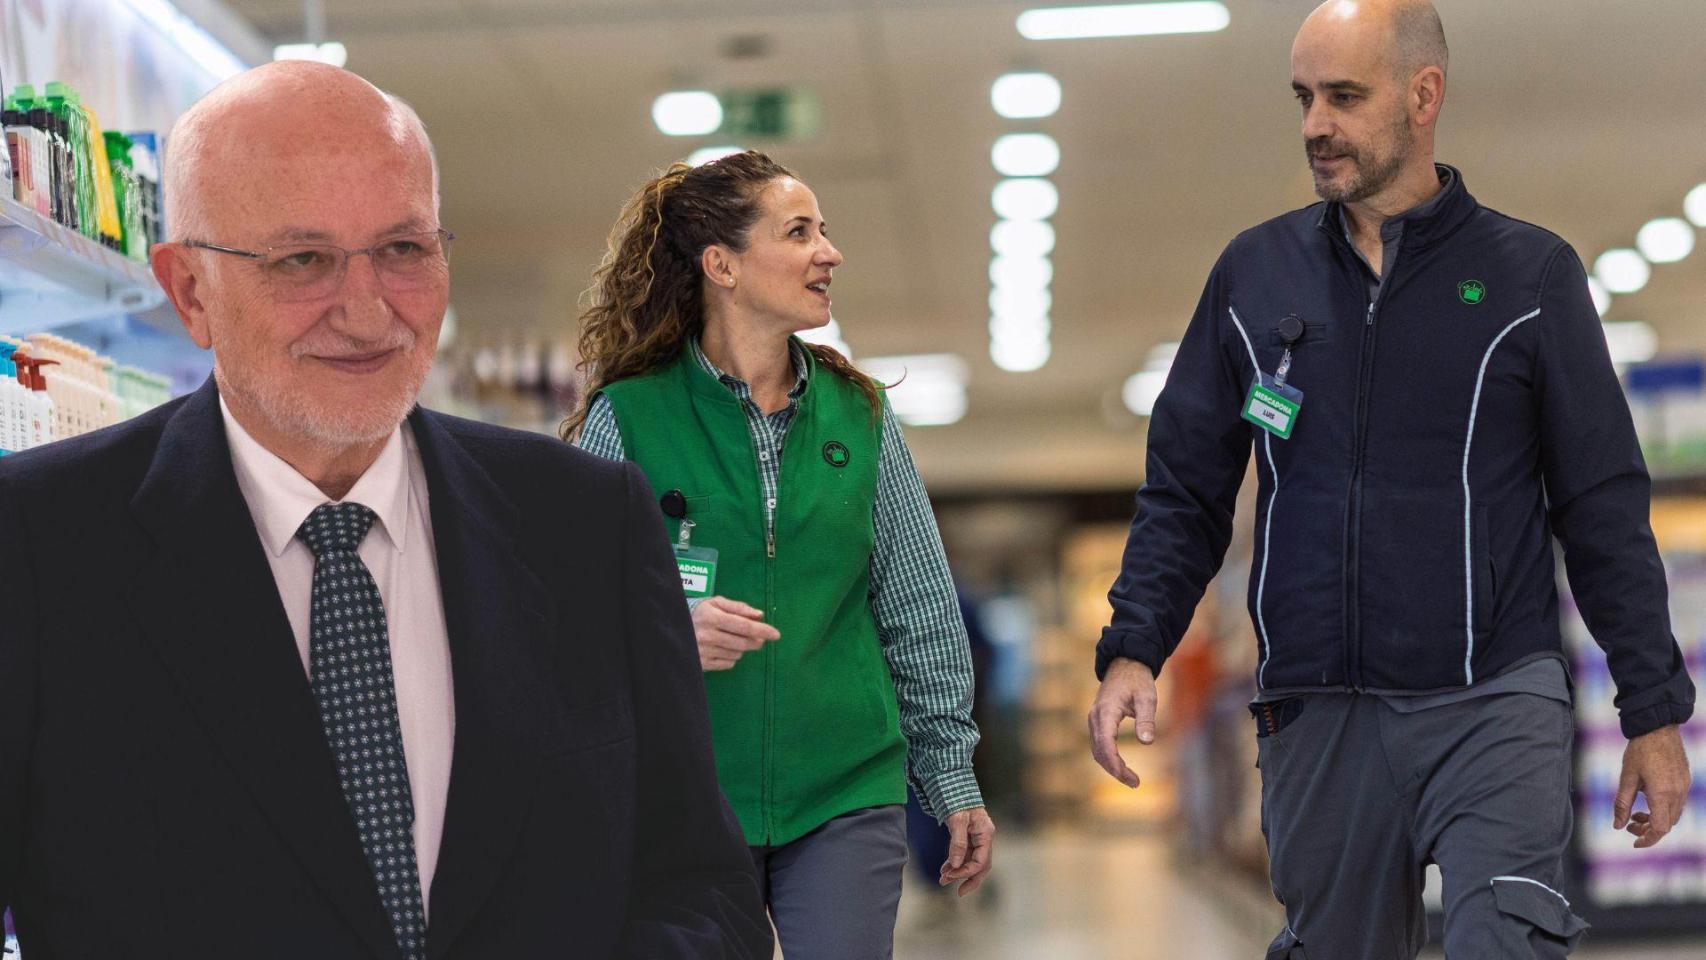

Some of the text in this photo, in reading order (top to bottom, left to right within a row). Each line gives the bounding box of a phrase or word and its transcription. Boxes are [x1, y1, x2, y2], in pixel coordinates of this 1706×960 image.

[1254, 390, 1292, 415] MERCADONA
[1262, 409, 1275, 420] LUIS
[678, 563, 708, 574] ADONA
